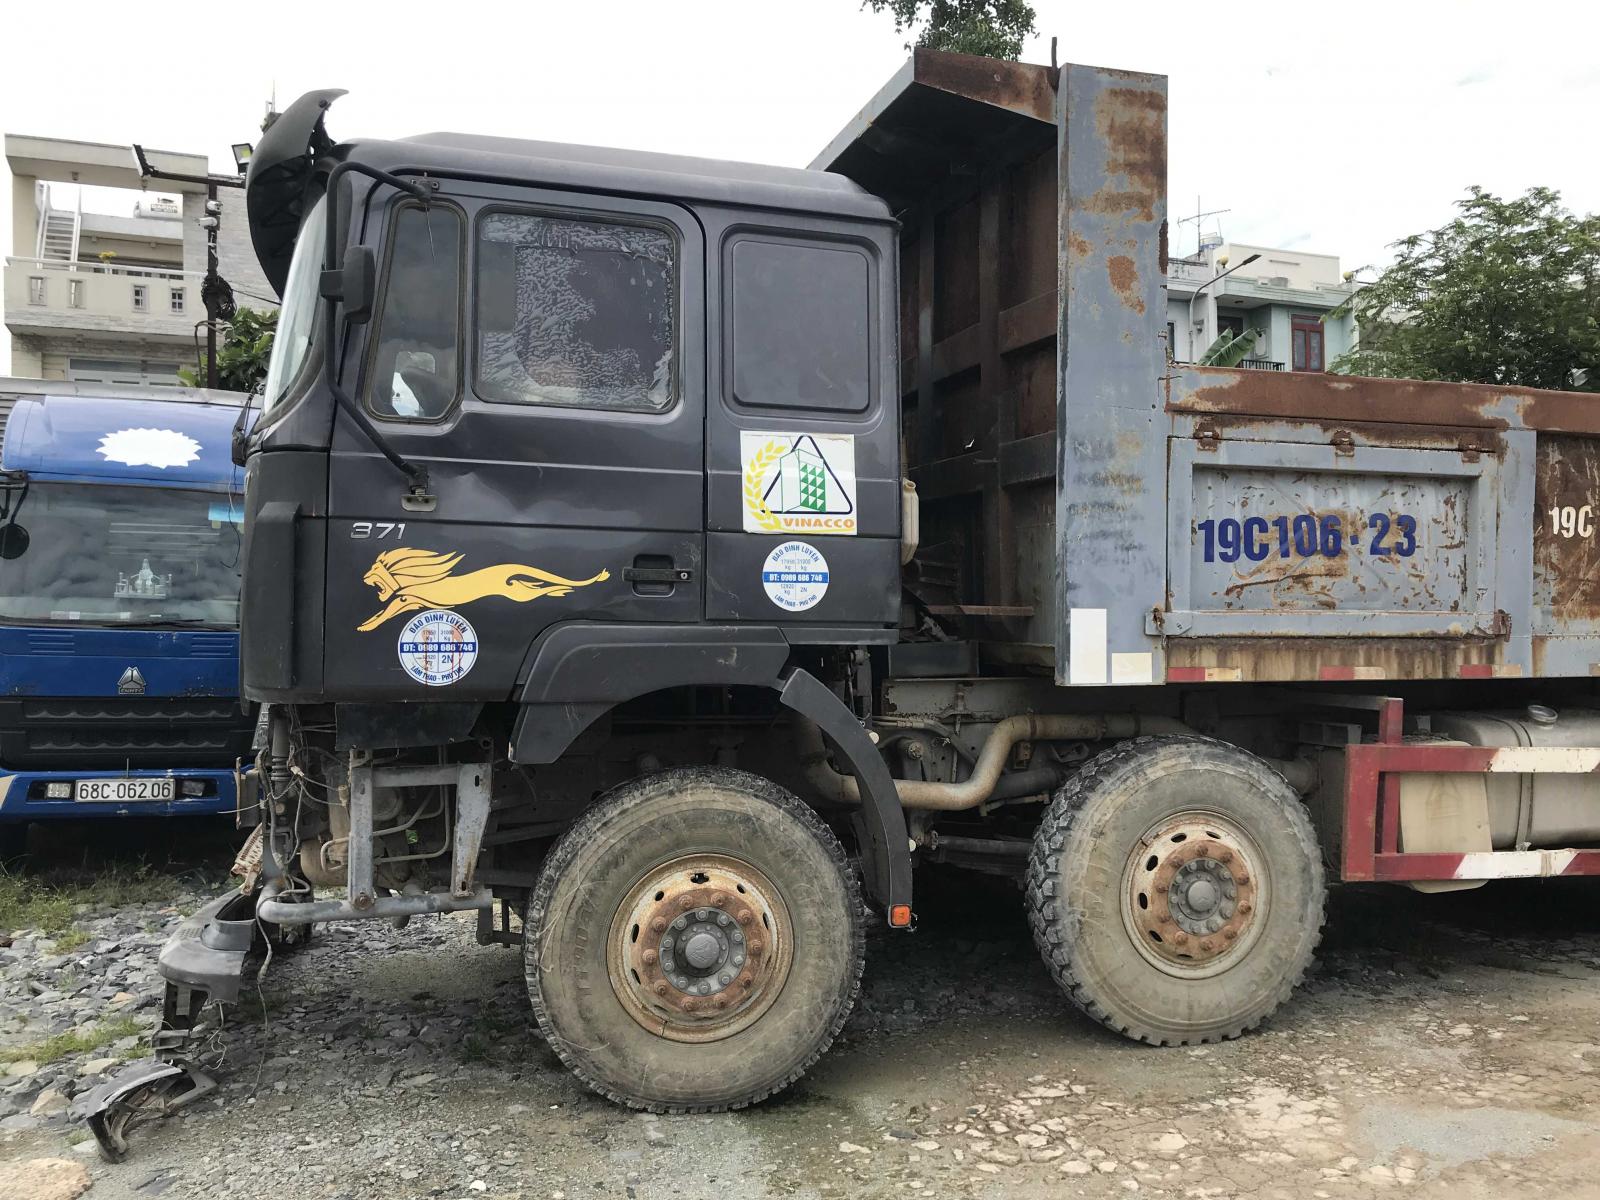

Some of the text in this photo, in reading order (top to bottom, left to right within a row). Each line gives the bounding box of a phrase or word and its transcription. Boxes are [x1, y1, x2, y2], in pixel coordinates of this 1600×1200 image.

[783, 518, 855, 529] VINACCO
[1548, 505, 1595, 538] 19C
[351, 522, 406, 540] 371
[80, 782, 171, 800] 68C-062.06
